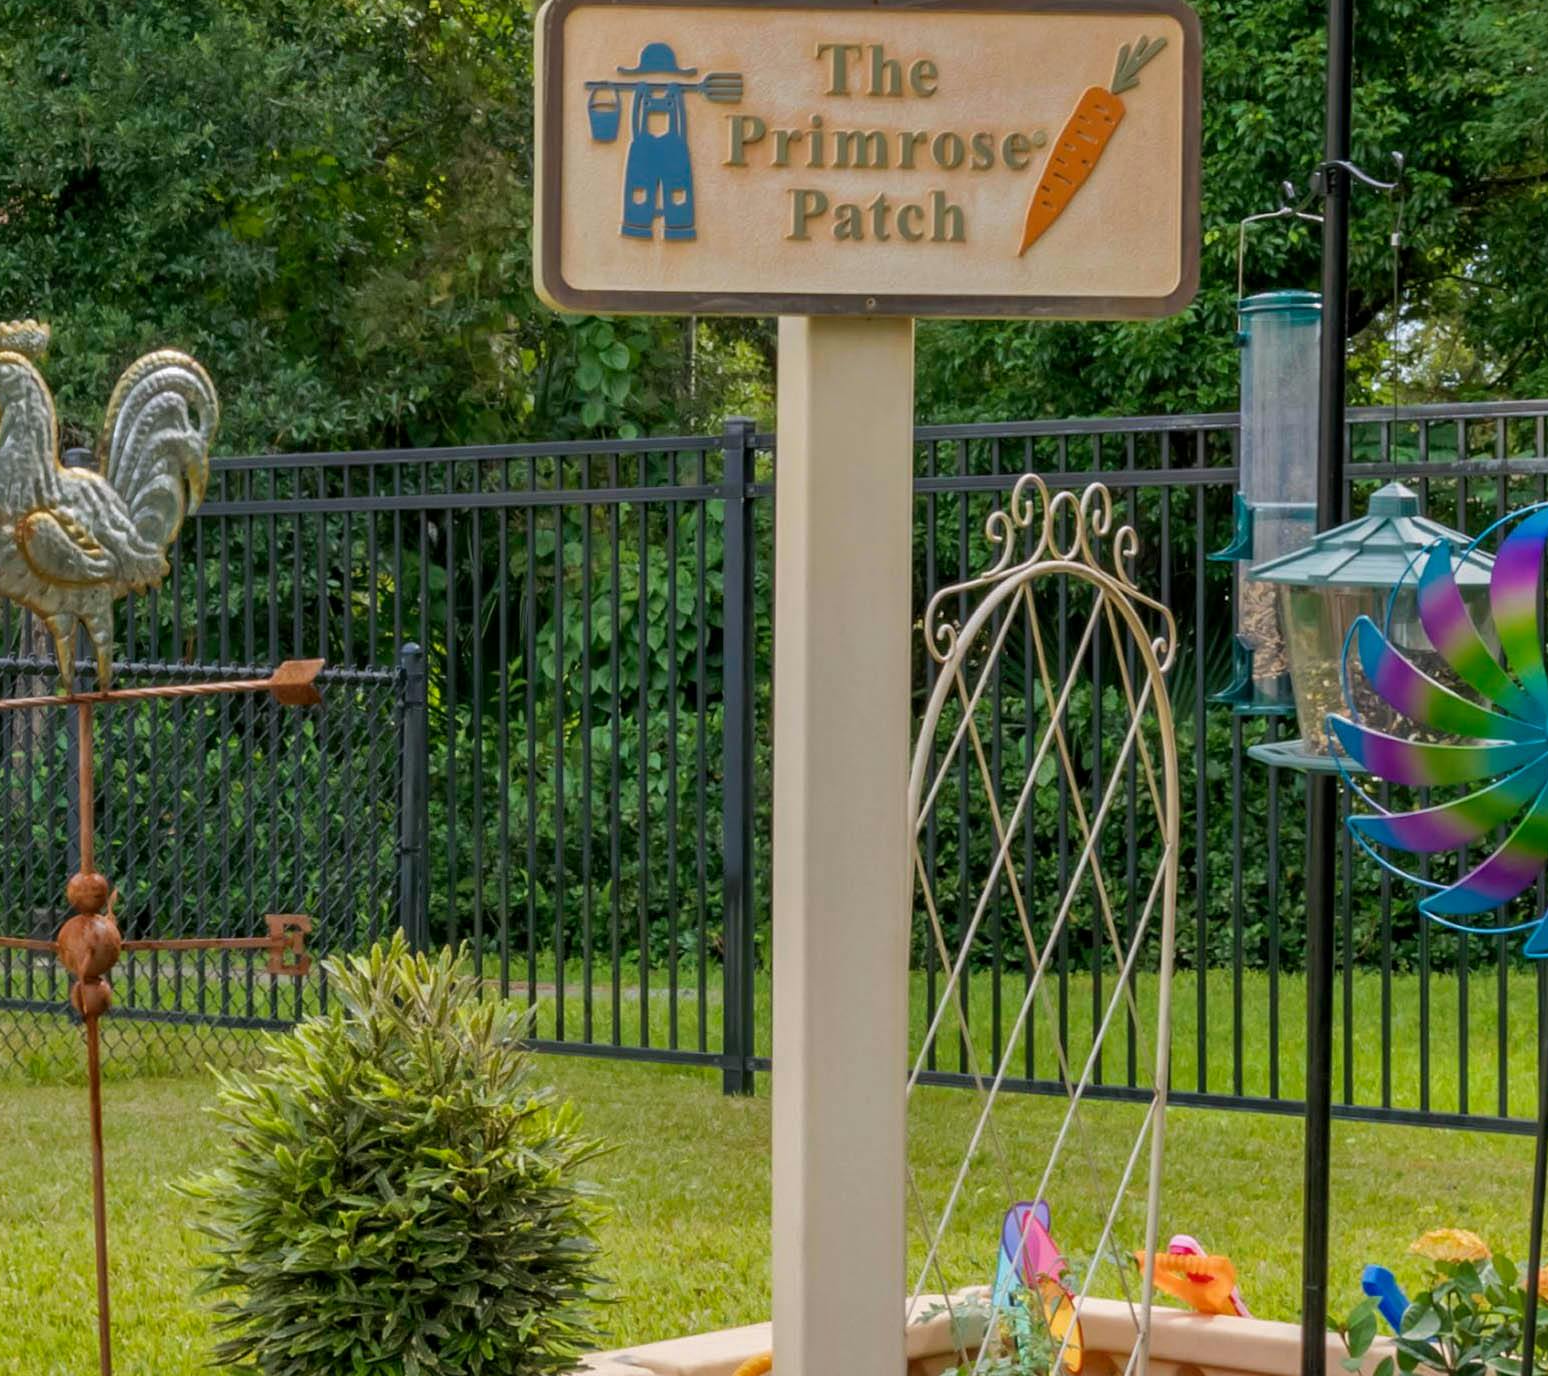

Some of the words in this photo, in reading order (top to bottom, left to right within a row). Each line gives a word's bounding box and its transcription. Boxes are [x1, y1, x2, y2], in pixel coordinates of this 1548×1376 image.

[815, 42, 939, 99] The
[784, 188, 966, 243] Patch
[264, 914, 312, 976] E
